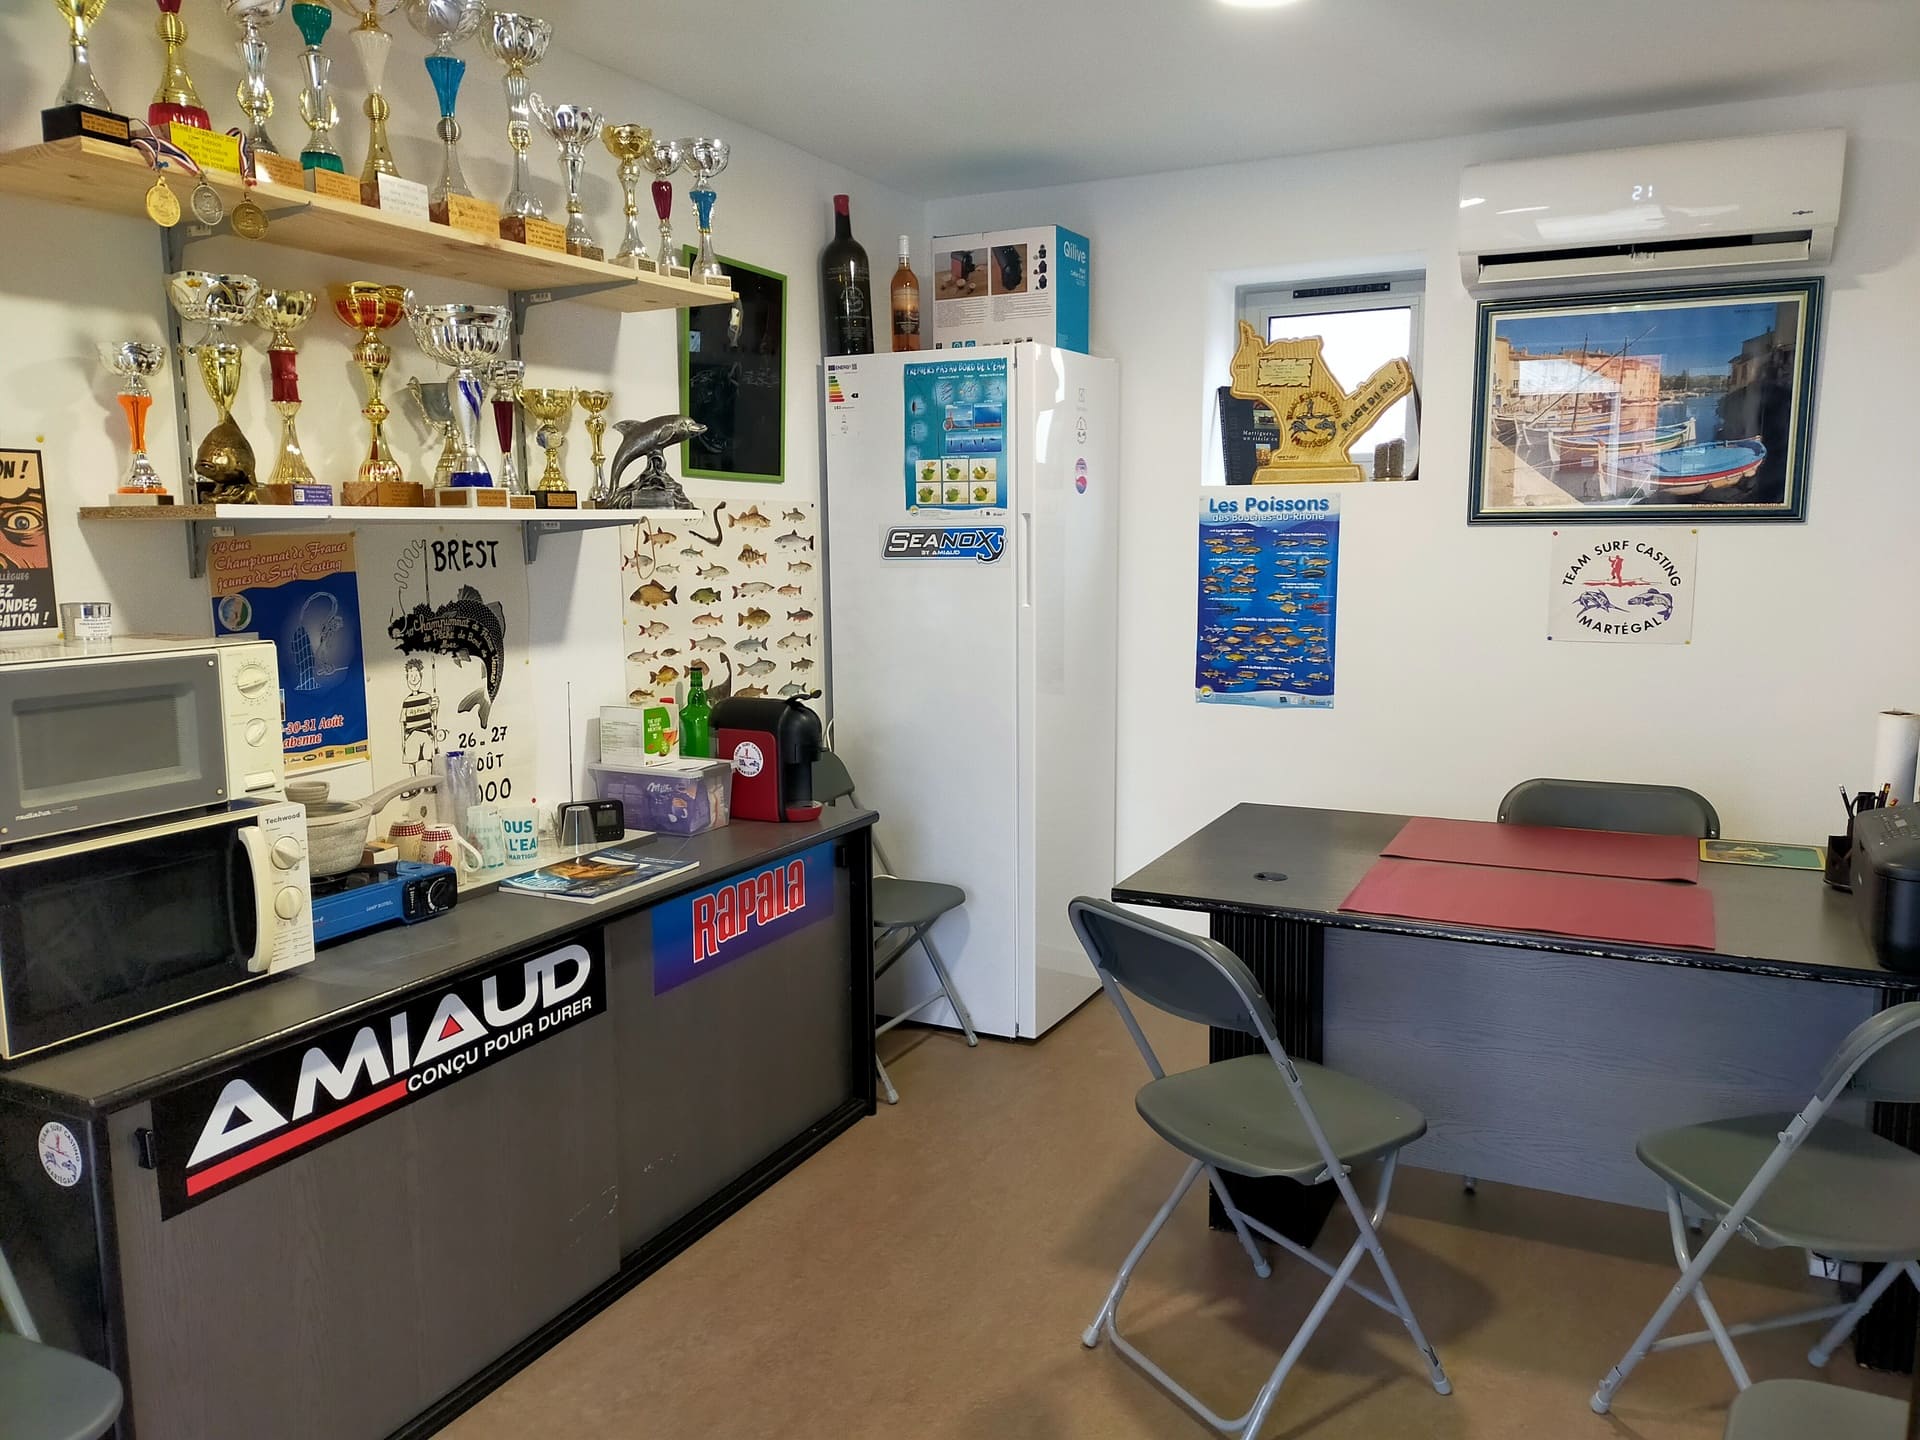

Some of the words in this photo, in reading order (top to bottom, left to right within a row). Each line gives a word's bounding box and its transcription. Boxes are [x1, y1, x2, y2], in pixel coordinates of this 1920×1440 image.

[1632, 185, 1653, 200] 21
[1063, 240, 1086, 264] Qilive
[1210, 498, 1238, 513] Les
[1246, 496, 1329, 512] Poissons
[1213, 514, 1230, 522] des
[888, 530, 1000, 554] SEANOX
[214, 550, 290, 571] Championnat
[291, 545, 304, 560] de
[305, 540, 347, 560] France
[430, 540, 499, 572] BREST
[1562, 554, 1591, 586] TEAM
[1594, 540, 1629, 556] SURF
[1636, 543, 1680, 586] CASTING
[216, 574, 251, 592] jeunes
[254, 569, 267, 583] de
[268, 564, 299, 584] Surf
[300, 558, 343, 574] Casting
[413, 613, 469, 632] Championnat
[1579, 616, 1662, 634] MARTÉGAL
[284, 719, 317, 735] -30-31
[319, 714, 344, 730] Août
[283, 733, 322, 749] abenne
[458, 731, 476, 749] 26
[491, 726, 508, 743] 27
[476, 752, 504, 772] OÛT
[479, 777, 511, 802] 00
[265, 812, 301, 825] Techwood
[503, 820, 533, 834] OUS
[509, 838, 538, 851] L'EA
[407, 1047, 479, 1092] CONÇU
[484, 1023, 534, 1057] POUR
[538, 996, 592, 1034] DURER
[186, 944, 590, 1168] AMIAUD
